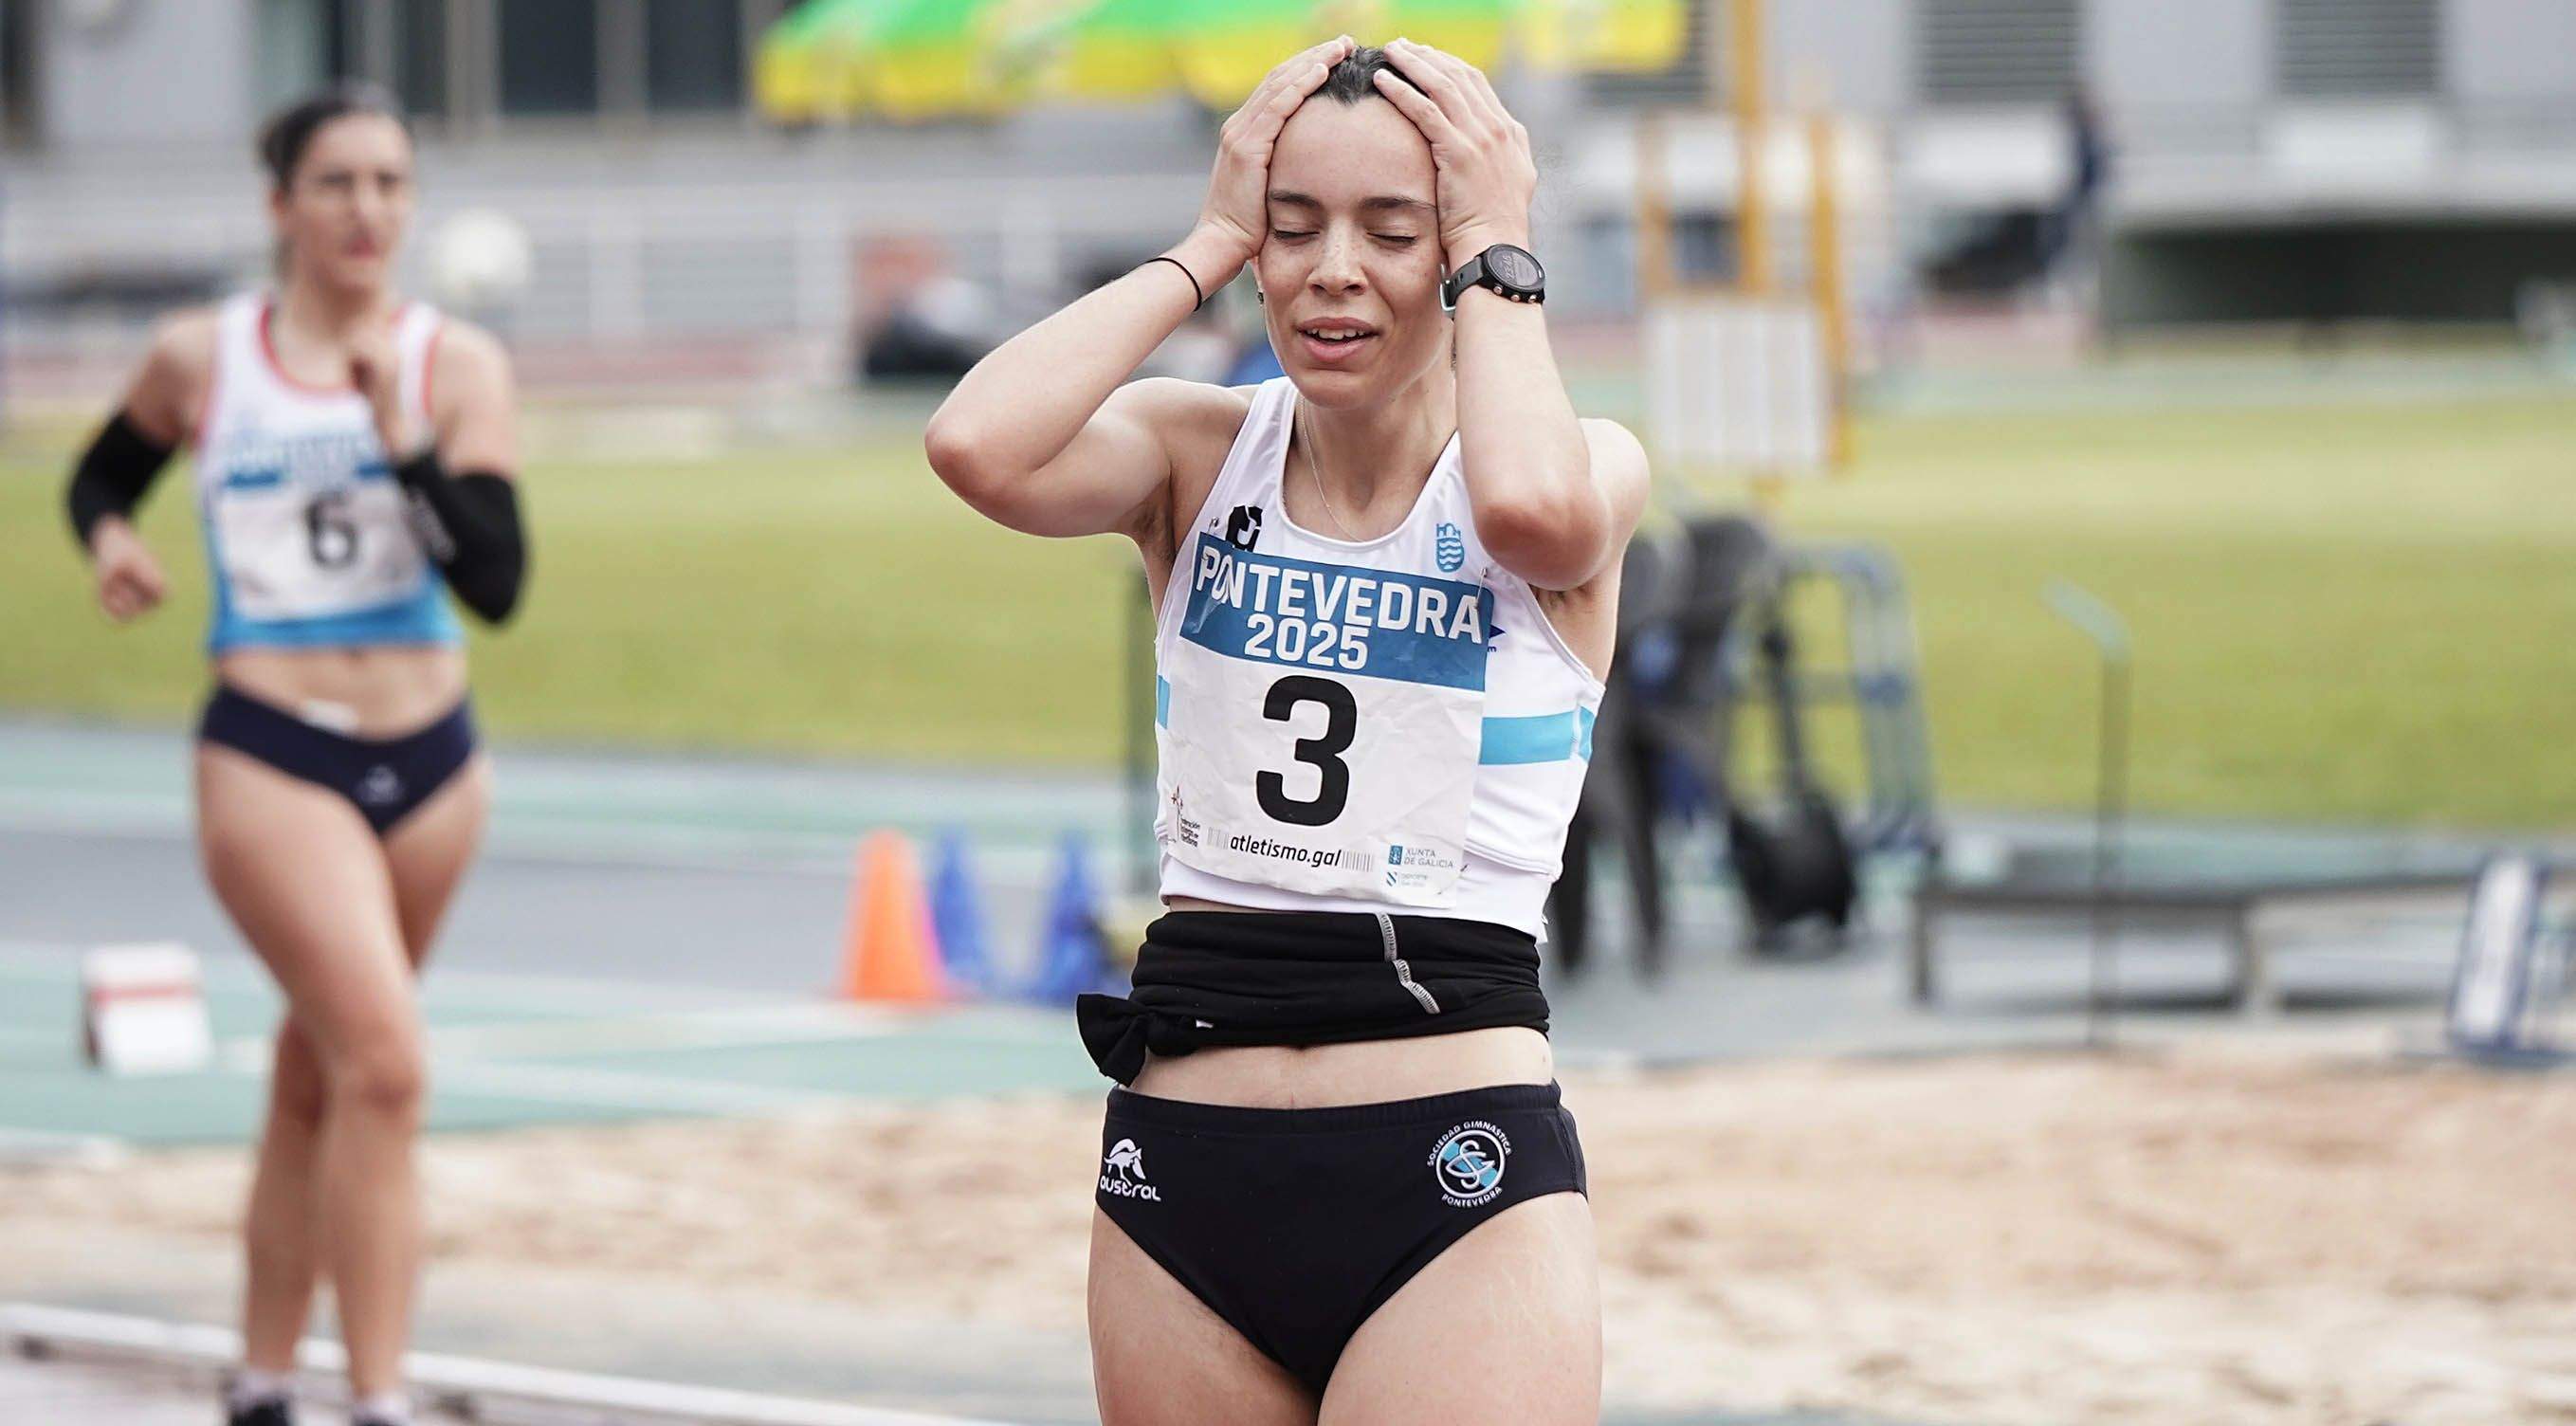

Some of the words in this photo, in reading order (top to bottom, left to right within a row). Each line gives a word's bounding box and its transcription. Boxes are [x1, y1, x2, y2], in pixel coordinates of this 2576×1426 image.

[306, 488, 358, 570] 6
[1196, 545, 1482, 644] PONTEVEDRA
[1244, 613, 1368, 669] 2025
[1256, 675, 1358, 827] 3
[1230, 834, 1342, 868] atletismo.gal
[1417, 857, 1453, 868] GALICIA
[1427, 1124, 1461, 1166] SOCIEDAD
[1442, 1186, 1502, 1207] PONTEVEDRA
